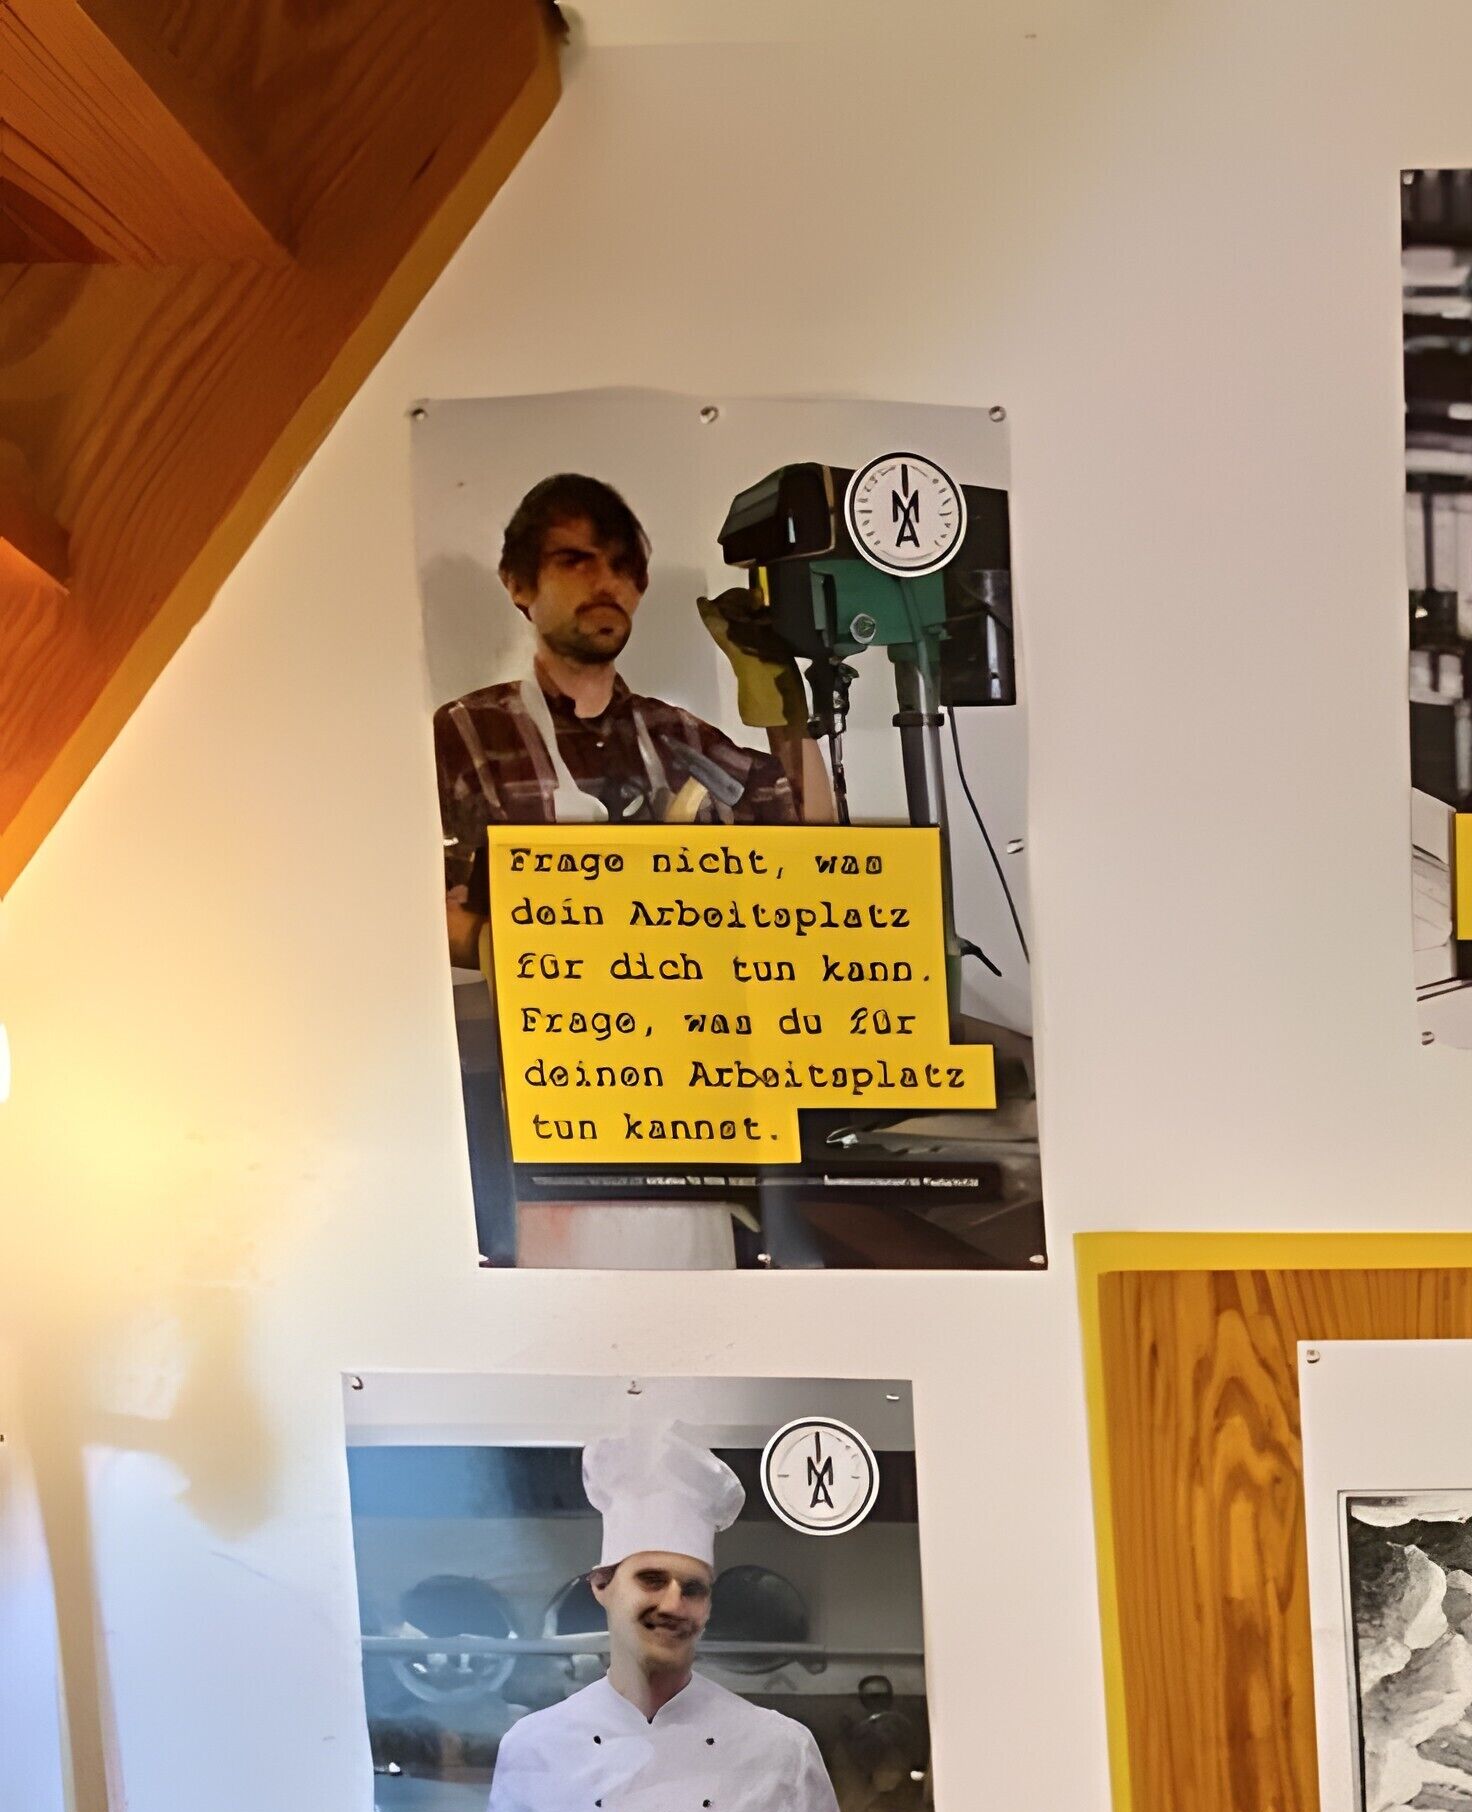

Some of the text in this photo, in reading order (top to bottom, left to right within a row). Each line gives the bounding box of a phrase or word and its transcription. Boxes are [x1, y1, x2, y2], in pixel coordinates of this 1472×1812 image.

[653, 847, 783, 879] nicht,
[518, 953, 929, 982] für dich tun kann.
[779, 1008, 822, 1034] du
[850, 1007, 915, 1034] für
[533, 1115, 597, 1139] tun
